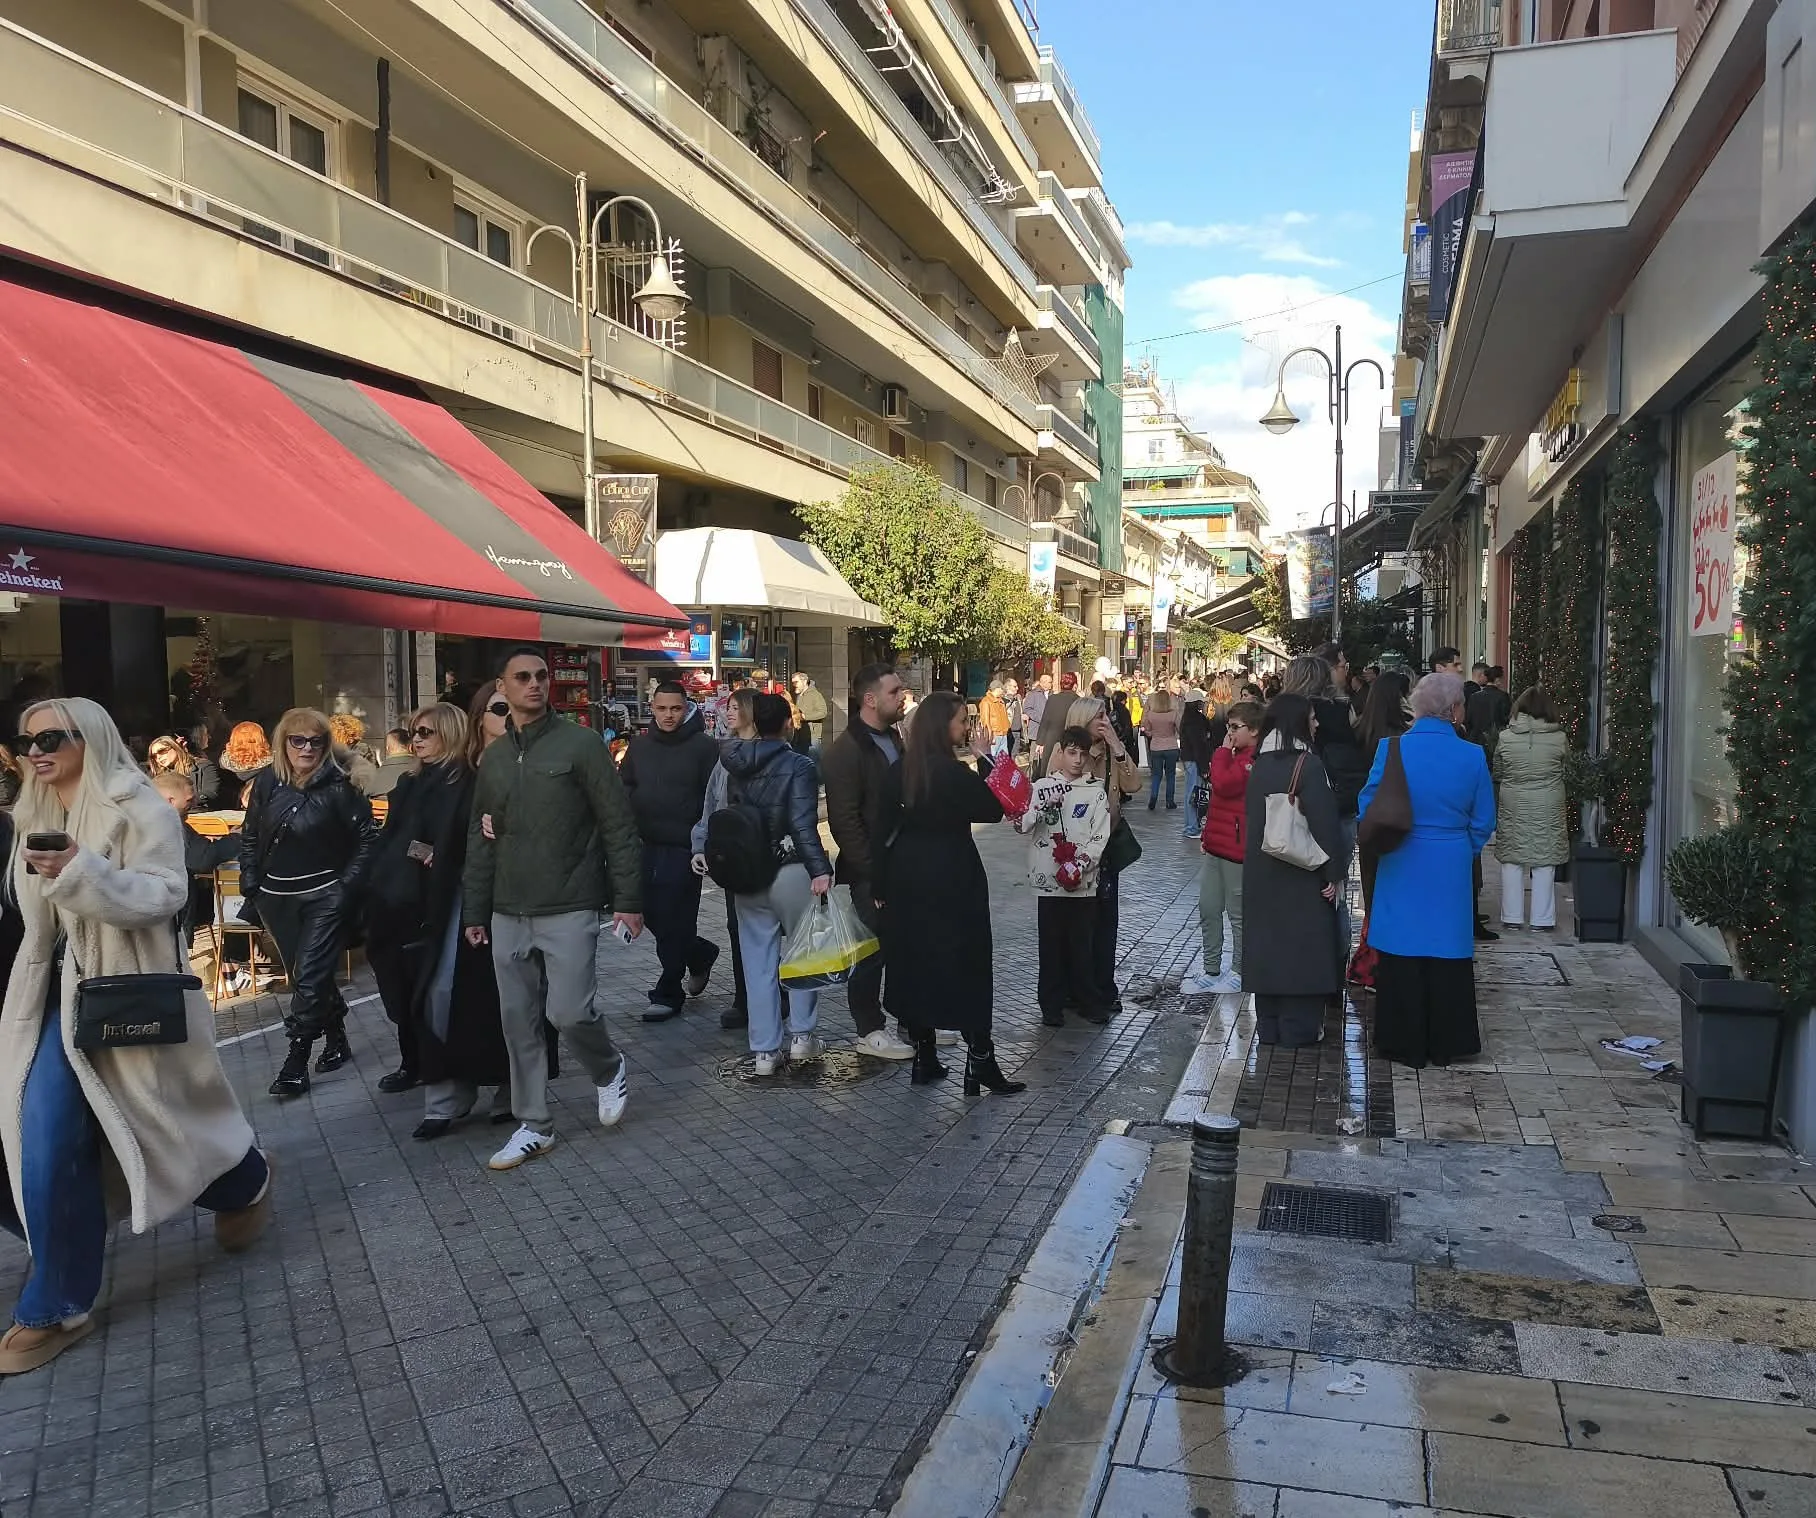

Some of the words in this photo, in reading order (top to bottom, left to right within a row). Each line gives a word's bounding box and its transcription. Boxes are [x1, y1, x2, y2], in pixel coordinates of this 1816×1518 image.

[1442, 233, 1450, 273] COSMETIC
[0, 571, 64, 591] eineken
[1694, 556, 1730, 630] 50%
